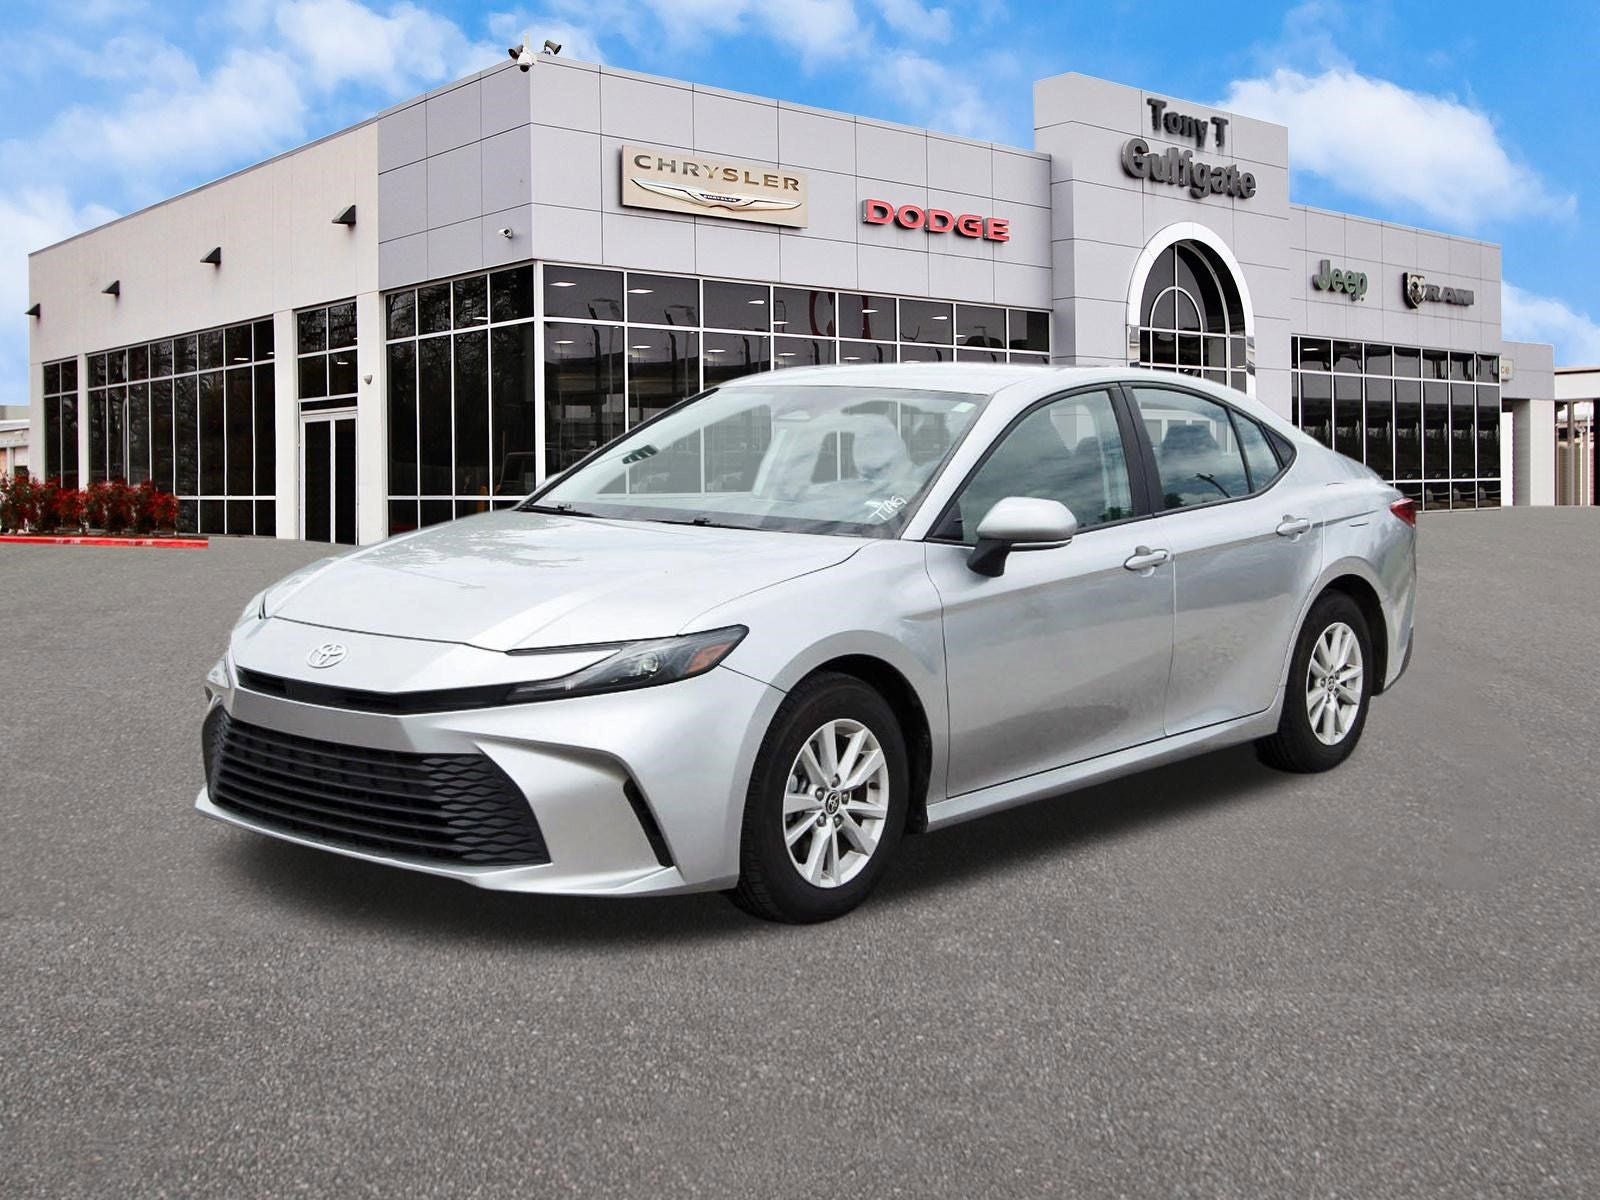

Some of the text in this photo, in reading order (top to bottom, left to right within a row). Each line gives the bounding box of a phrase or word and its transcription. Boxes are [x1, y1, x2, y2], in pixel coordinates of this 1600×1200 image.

[1147, 98, 1229, 148] Tony T
[633, 154, 800, 192] CHRYSLER
[1121, 137, 1257, 199] Gulfgate
[862, 199, 1010, 243] DODGE
[1312, 259, 1368, 302] Jeep
[1424, 284, 1475, 307] RAM
